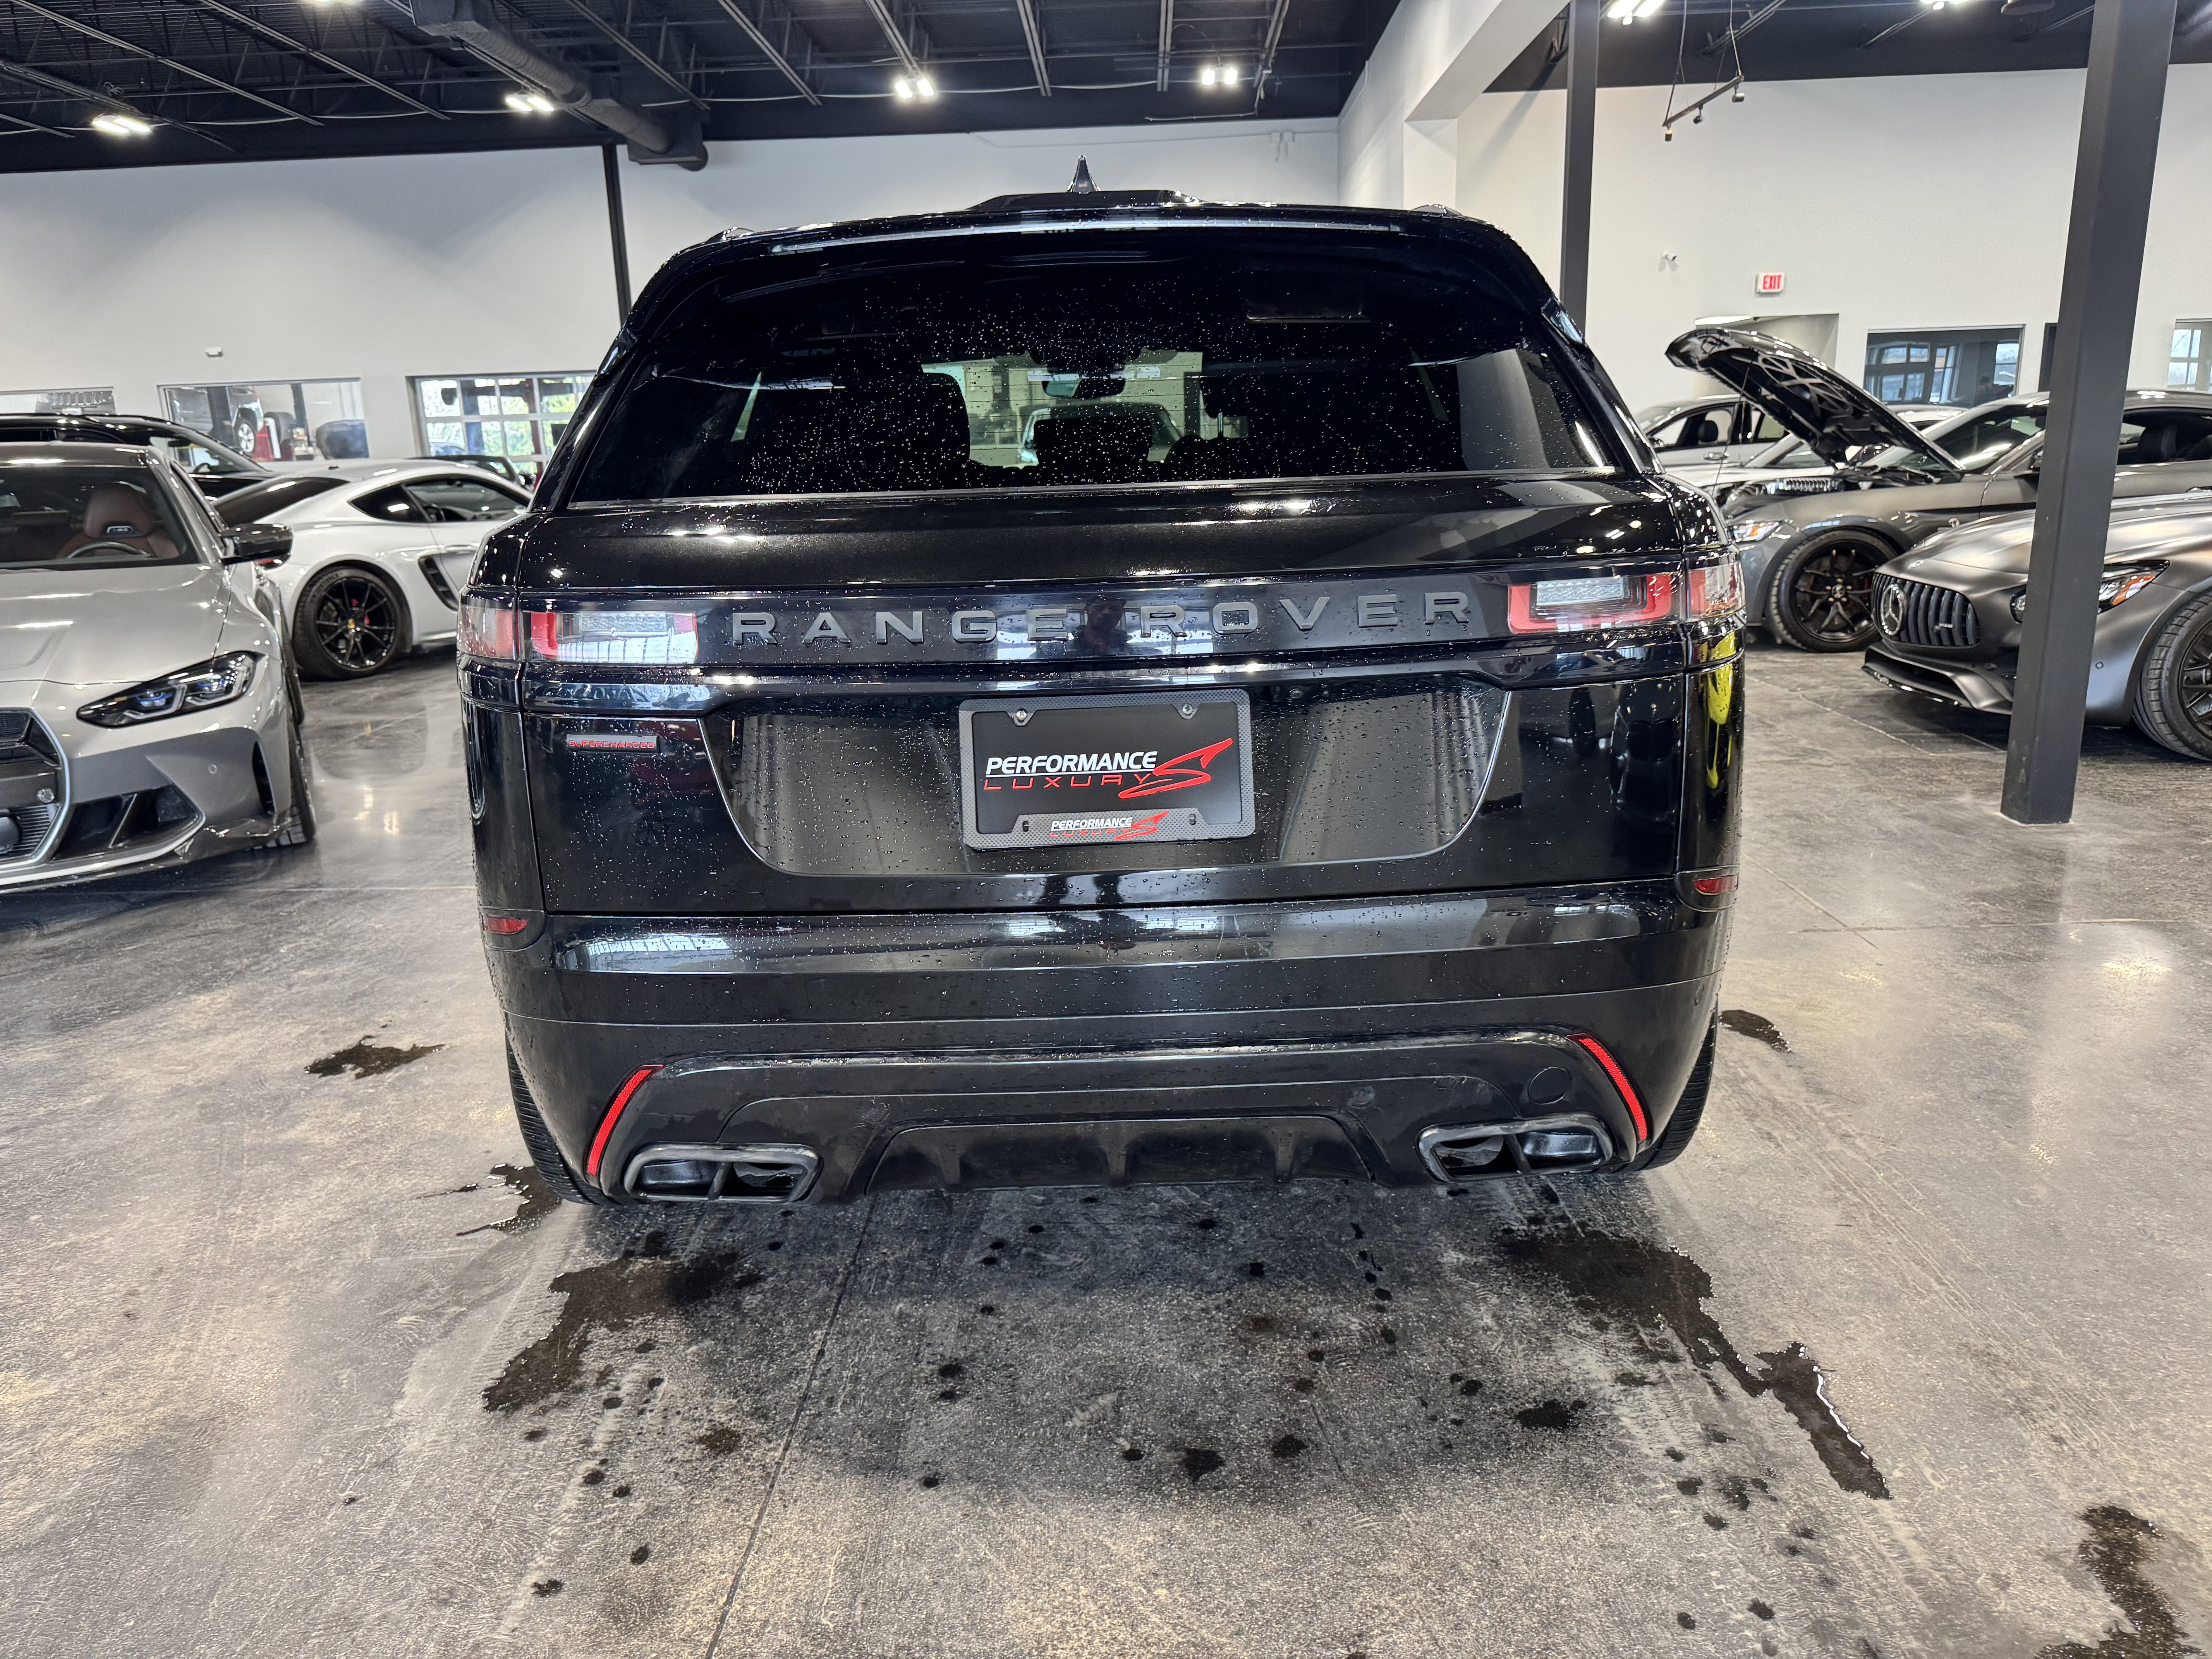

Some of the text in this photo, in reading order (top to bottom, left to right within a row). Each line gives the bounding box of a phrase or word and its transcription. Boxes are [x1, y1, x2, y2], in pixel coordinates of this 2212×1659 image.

[1763, 275, 1782, 290] EXIT
[732, 591, 1469, 644] RANGE ROVER
[568, 740, 655, 749] SUPERCHARGED
[986, 750, 1158, 775] PERFORMANCE
[984, 773, 1152, 790] LUXURY
[1051, 817, 1133, 830] PERFORMANCE
[1050, 827, 1130, 838] LUXURY
